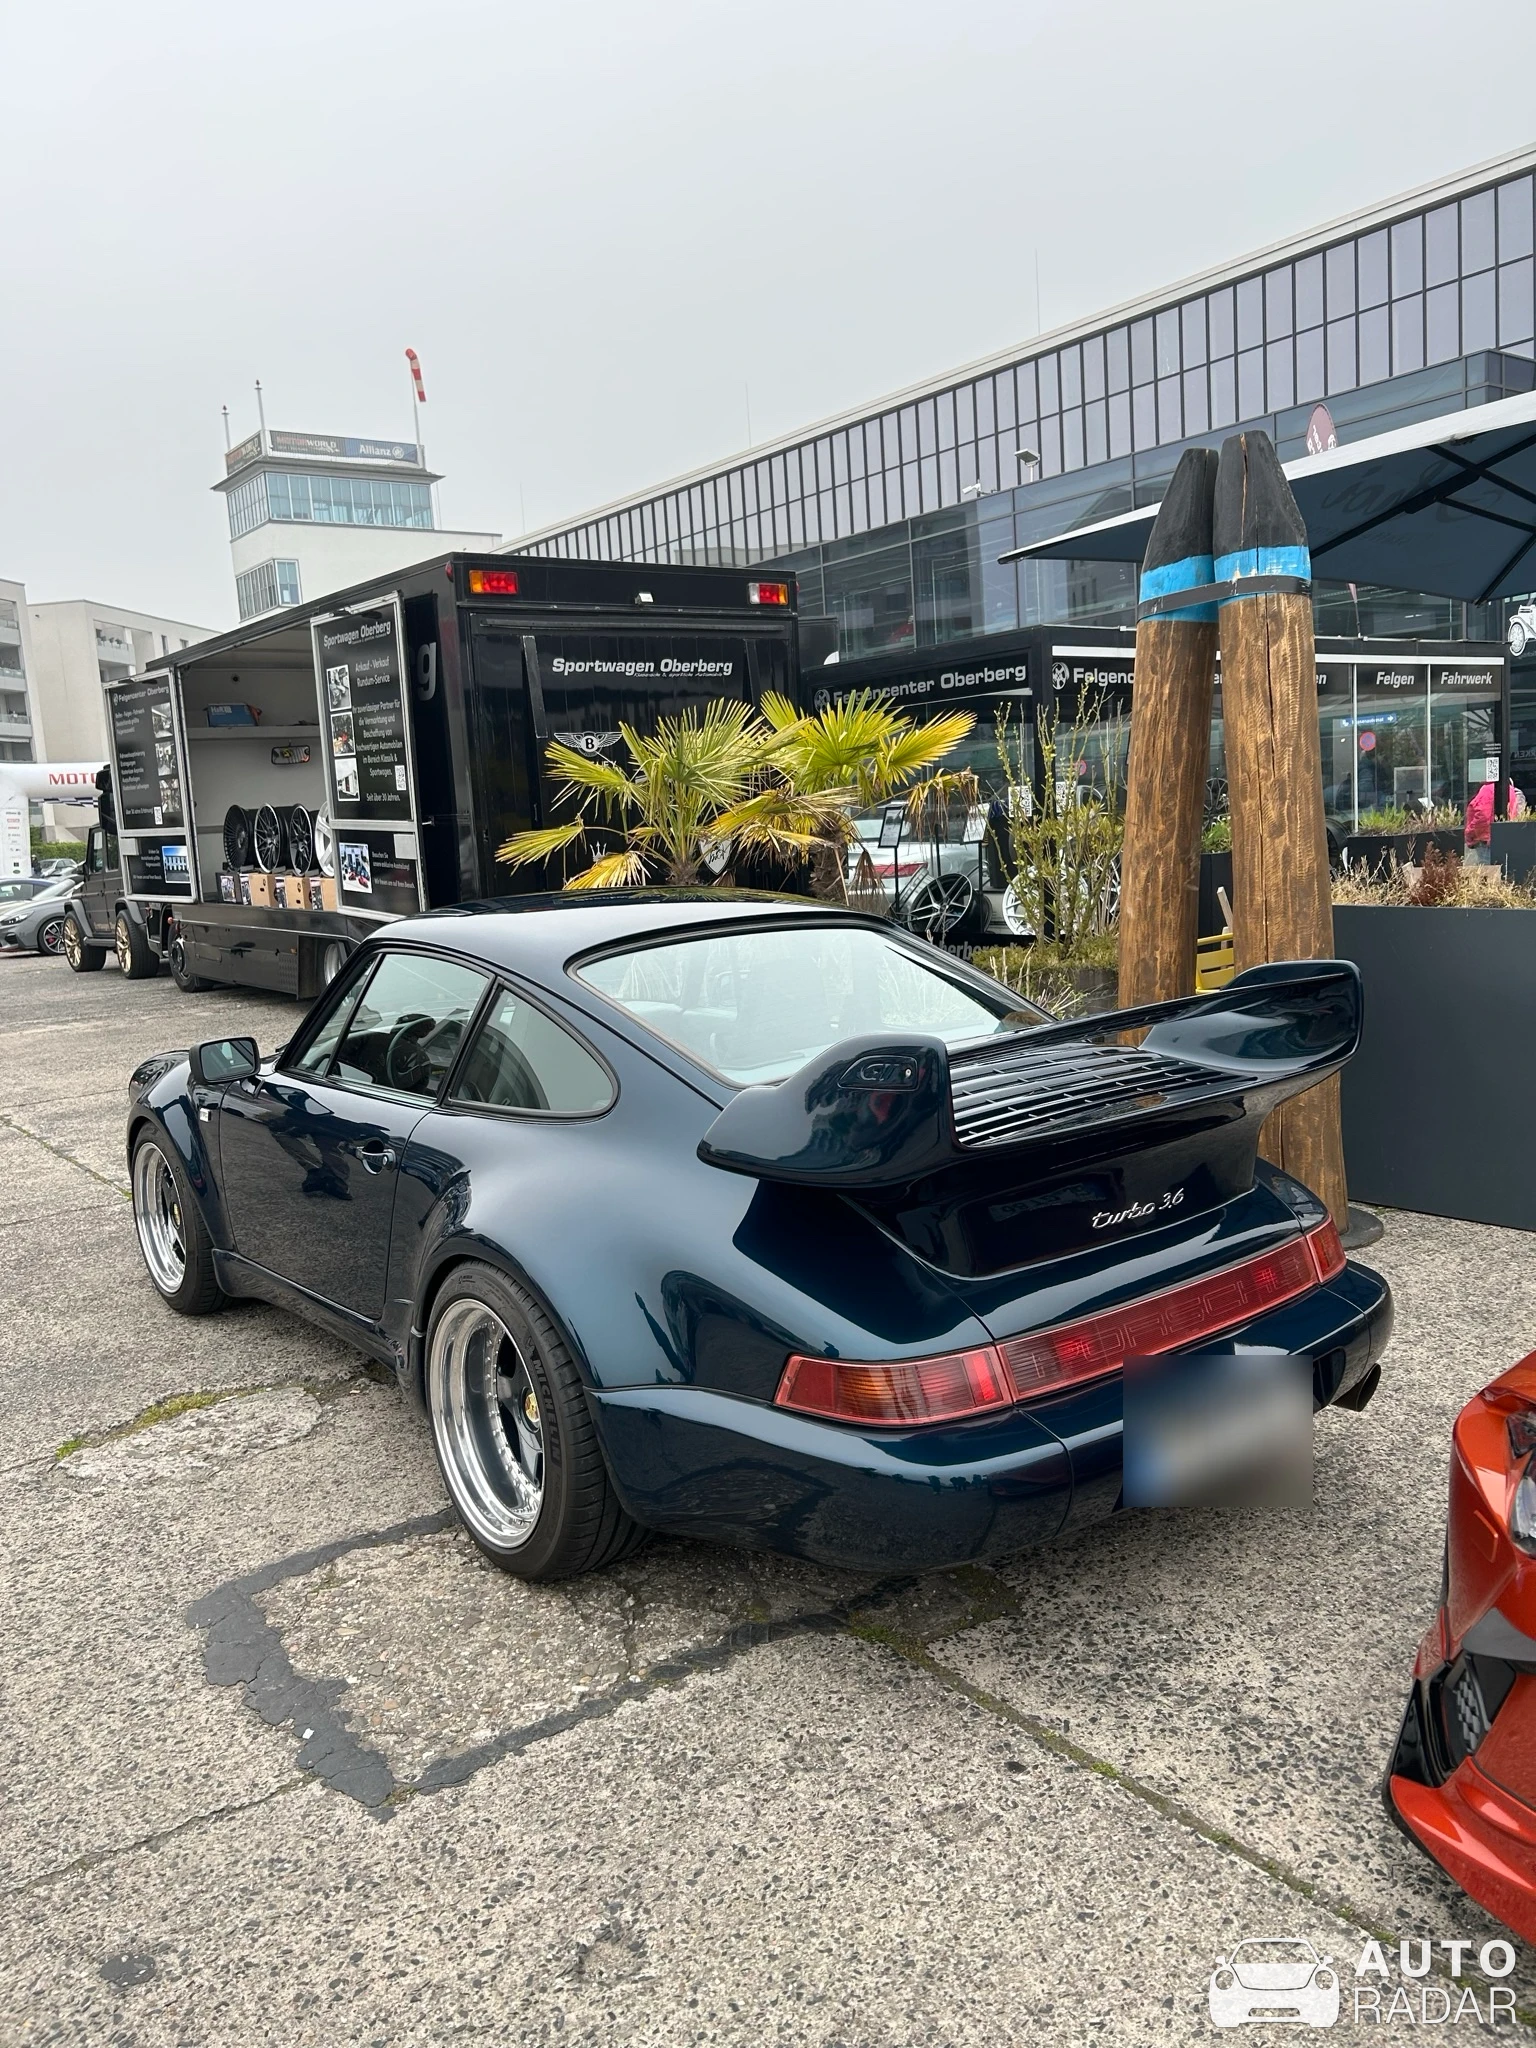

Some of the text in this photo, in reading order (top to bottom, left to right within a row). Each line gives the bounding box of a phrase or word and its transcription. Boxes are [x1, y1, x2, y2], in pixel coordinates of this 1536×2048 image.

[359, 444, 392, 456] Allianz
[323, 630, 359, 649] Sportwagen
[360, 621, 391, 638] Oberberg
[552, 658, 733, 676] Sportwagen Oberberg
[833, 665, 1027, 706] Fegencenter Oberberg
[1073, 668, 1136, 687] Felgenc
[1376, 671, 1415, 688] Felgen
[1440, 671, 1493, 685] Fahrwerk
[585, 738, 595, 749] B
[1092, 1202, 1156, 1229] turbo
[532, 1360, 562, 1468] MICHELIN
